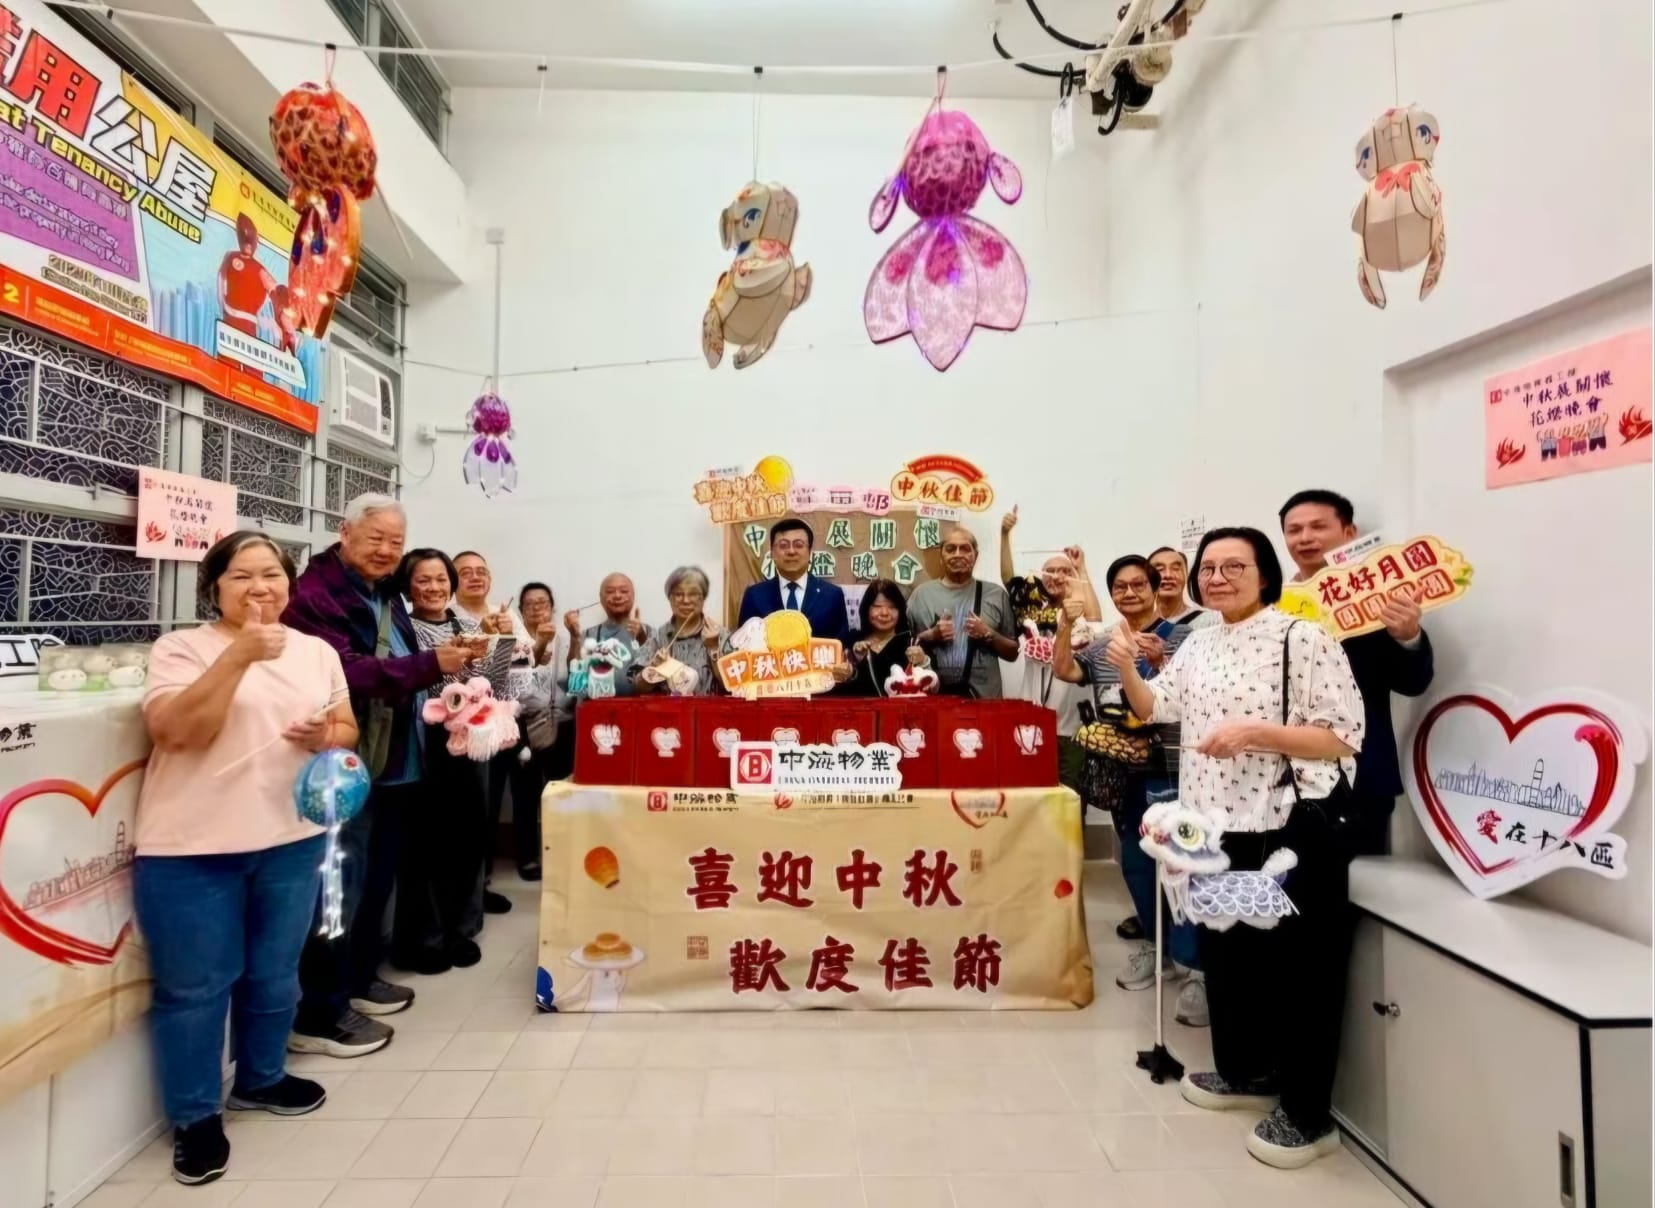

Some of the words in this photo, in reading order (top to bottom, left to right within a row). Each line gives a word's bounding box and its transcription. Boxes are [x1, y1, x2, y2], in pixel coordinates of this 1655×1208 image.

[31, 115, 141, 203] Tenancy
[3, 282, 20, 304] 2
[898, 476, 989, 507] 中秋佳節
[745, 518, 940, 558] 中展關懷
[1318, 540, 1438, 608] 花好月圓
[726, 645, 837, 684] 中秋快樂
[778, 749, 895, 771] 中海物業
[1476, 808, 1615, 870] 愛在十八區
[685, 845, 965, 911] 喜迎中秋
[728, 932, 1004, 994] 歡度佳節
